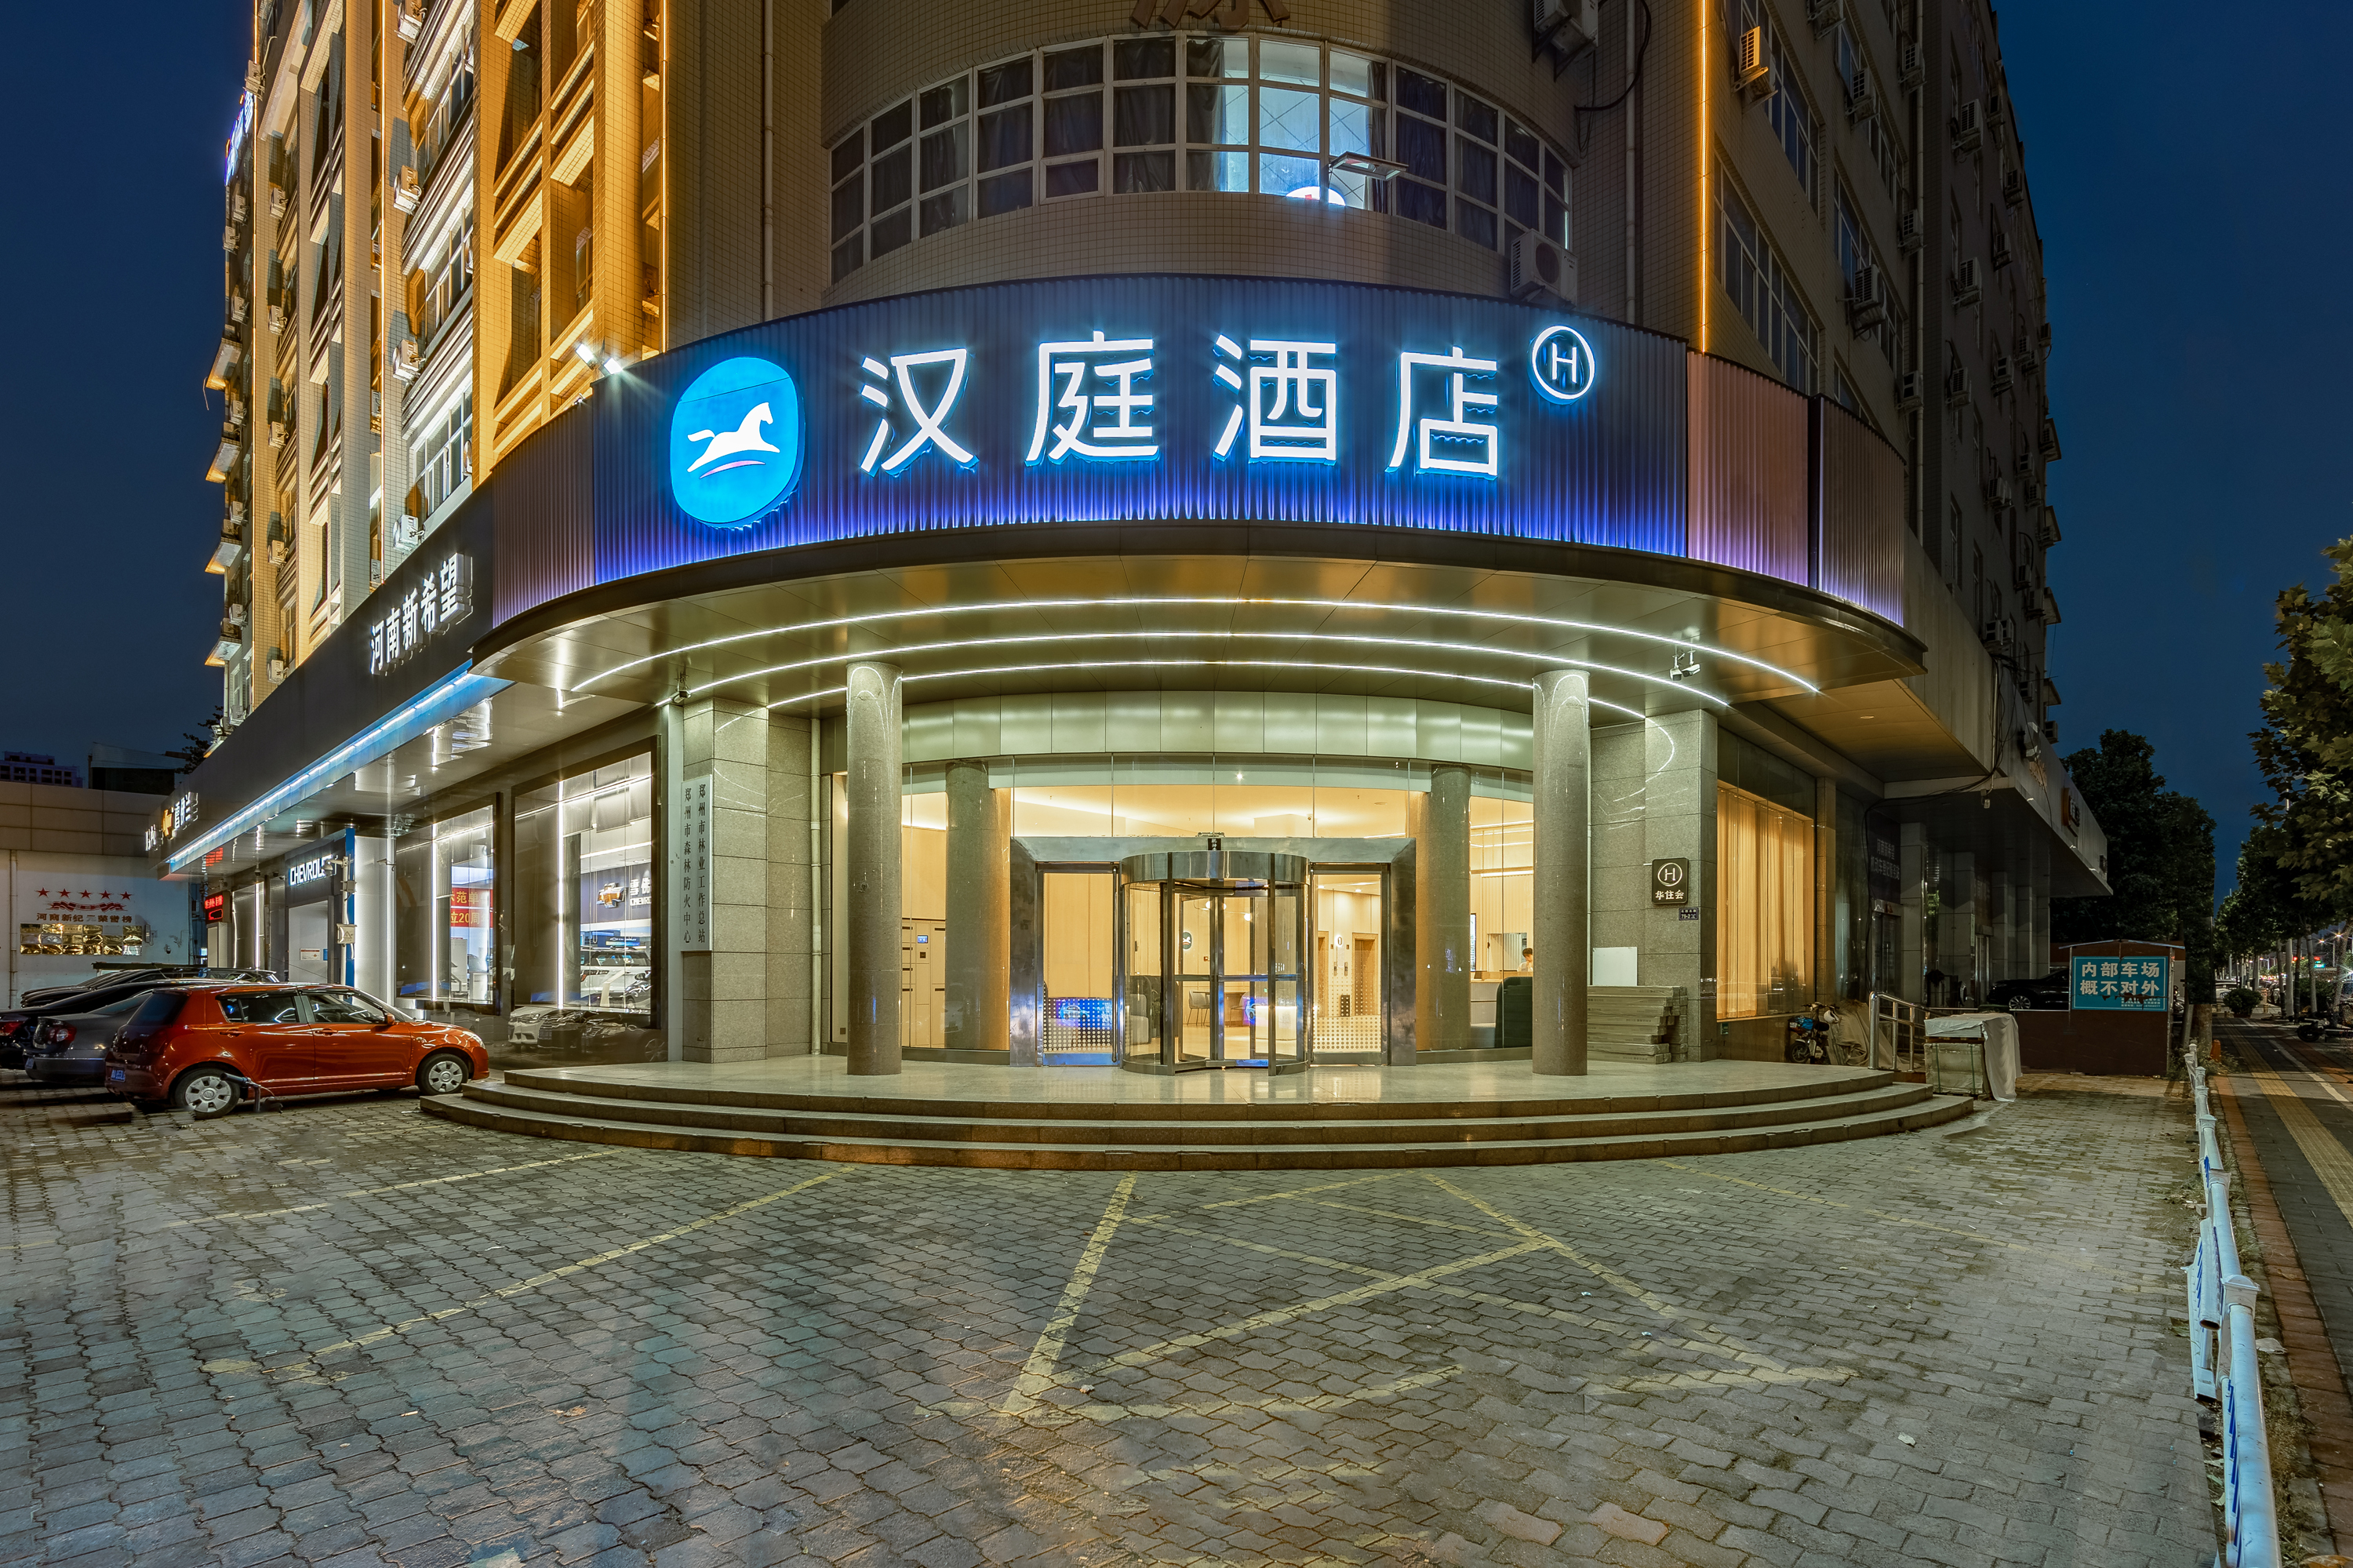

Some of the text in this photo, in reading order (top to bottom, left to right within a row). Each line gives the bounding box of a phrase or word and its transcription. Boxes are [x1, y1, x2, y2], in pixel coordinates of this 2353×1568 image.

[859, 330, 1499, 478] 汉庭酒店
[370, 552, 459, 675] 河南新希望
[683, 788, 692, 944] 郑州市森林防火中心
[697, 784, 707, 944] 郑州市林业工作总站
[1655, 890, 1684, 900] 华住会
[2080, 980, 2159, 995] 概不对外
[2082, 962, 2159, 977] 内部车场
